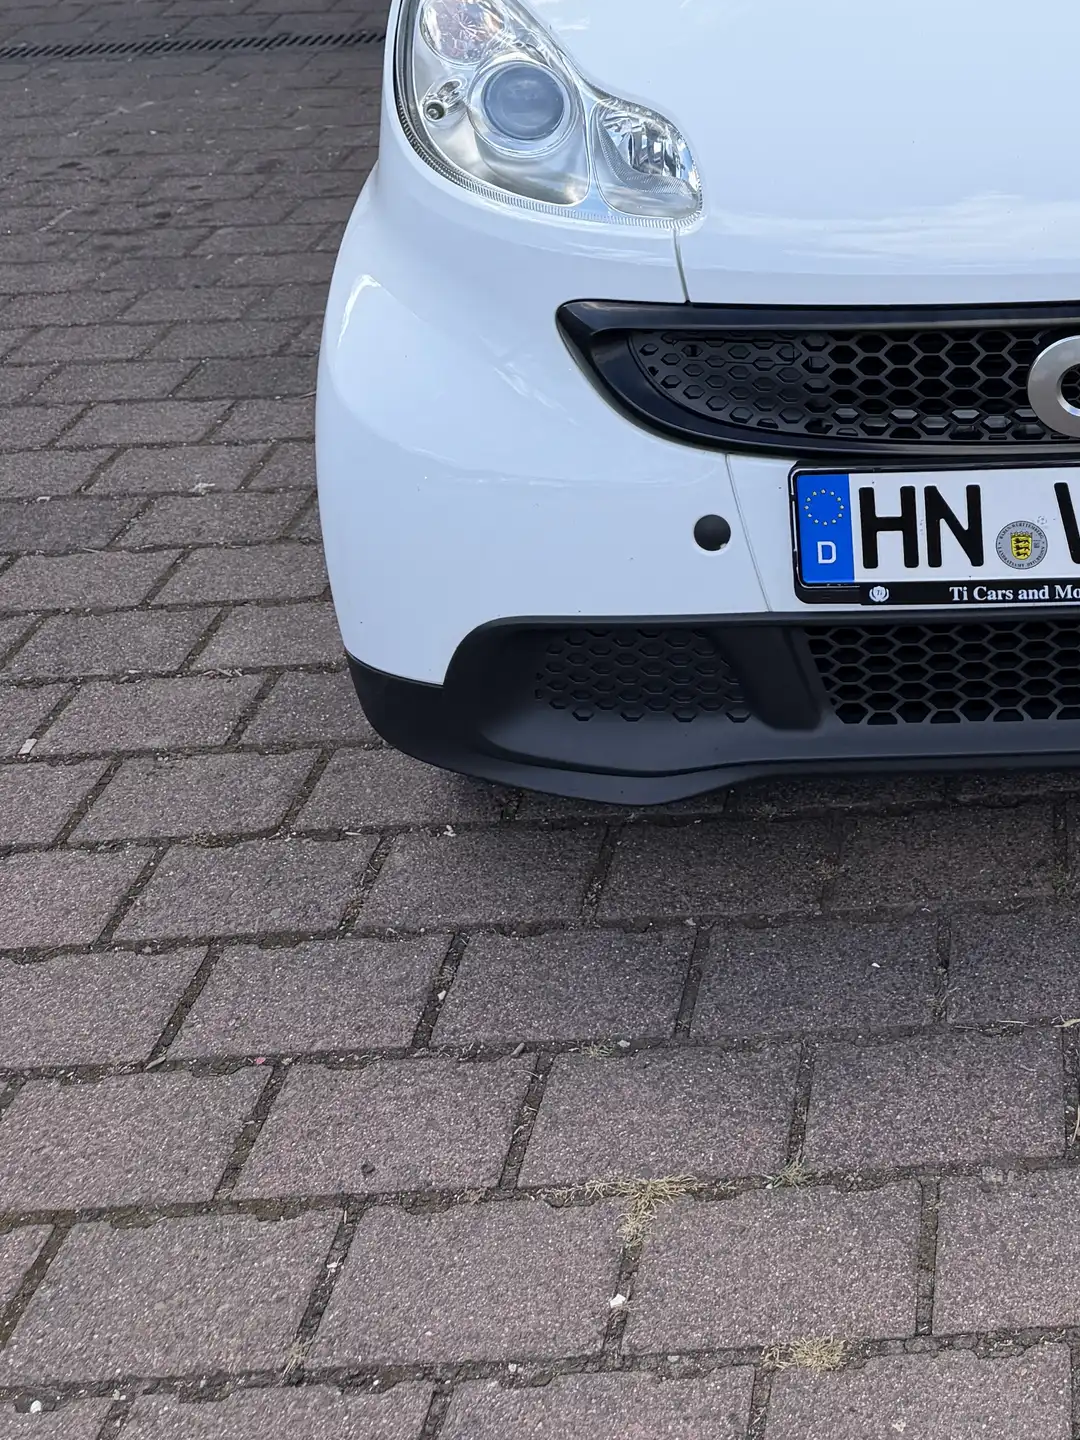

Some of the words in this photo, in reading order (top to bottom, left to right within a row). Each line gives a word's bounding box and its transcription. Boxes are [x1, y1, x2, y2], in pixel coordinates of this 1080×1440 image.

[858, 484, 984, 569] HN
[817, 540, 837, 564] D
[949, 586, 968, 601] Ti
[973, 586, 1014, 601] Cars
[1018, 585, 1049, 600] and
